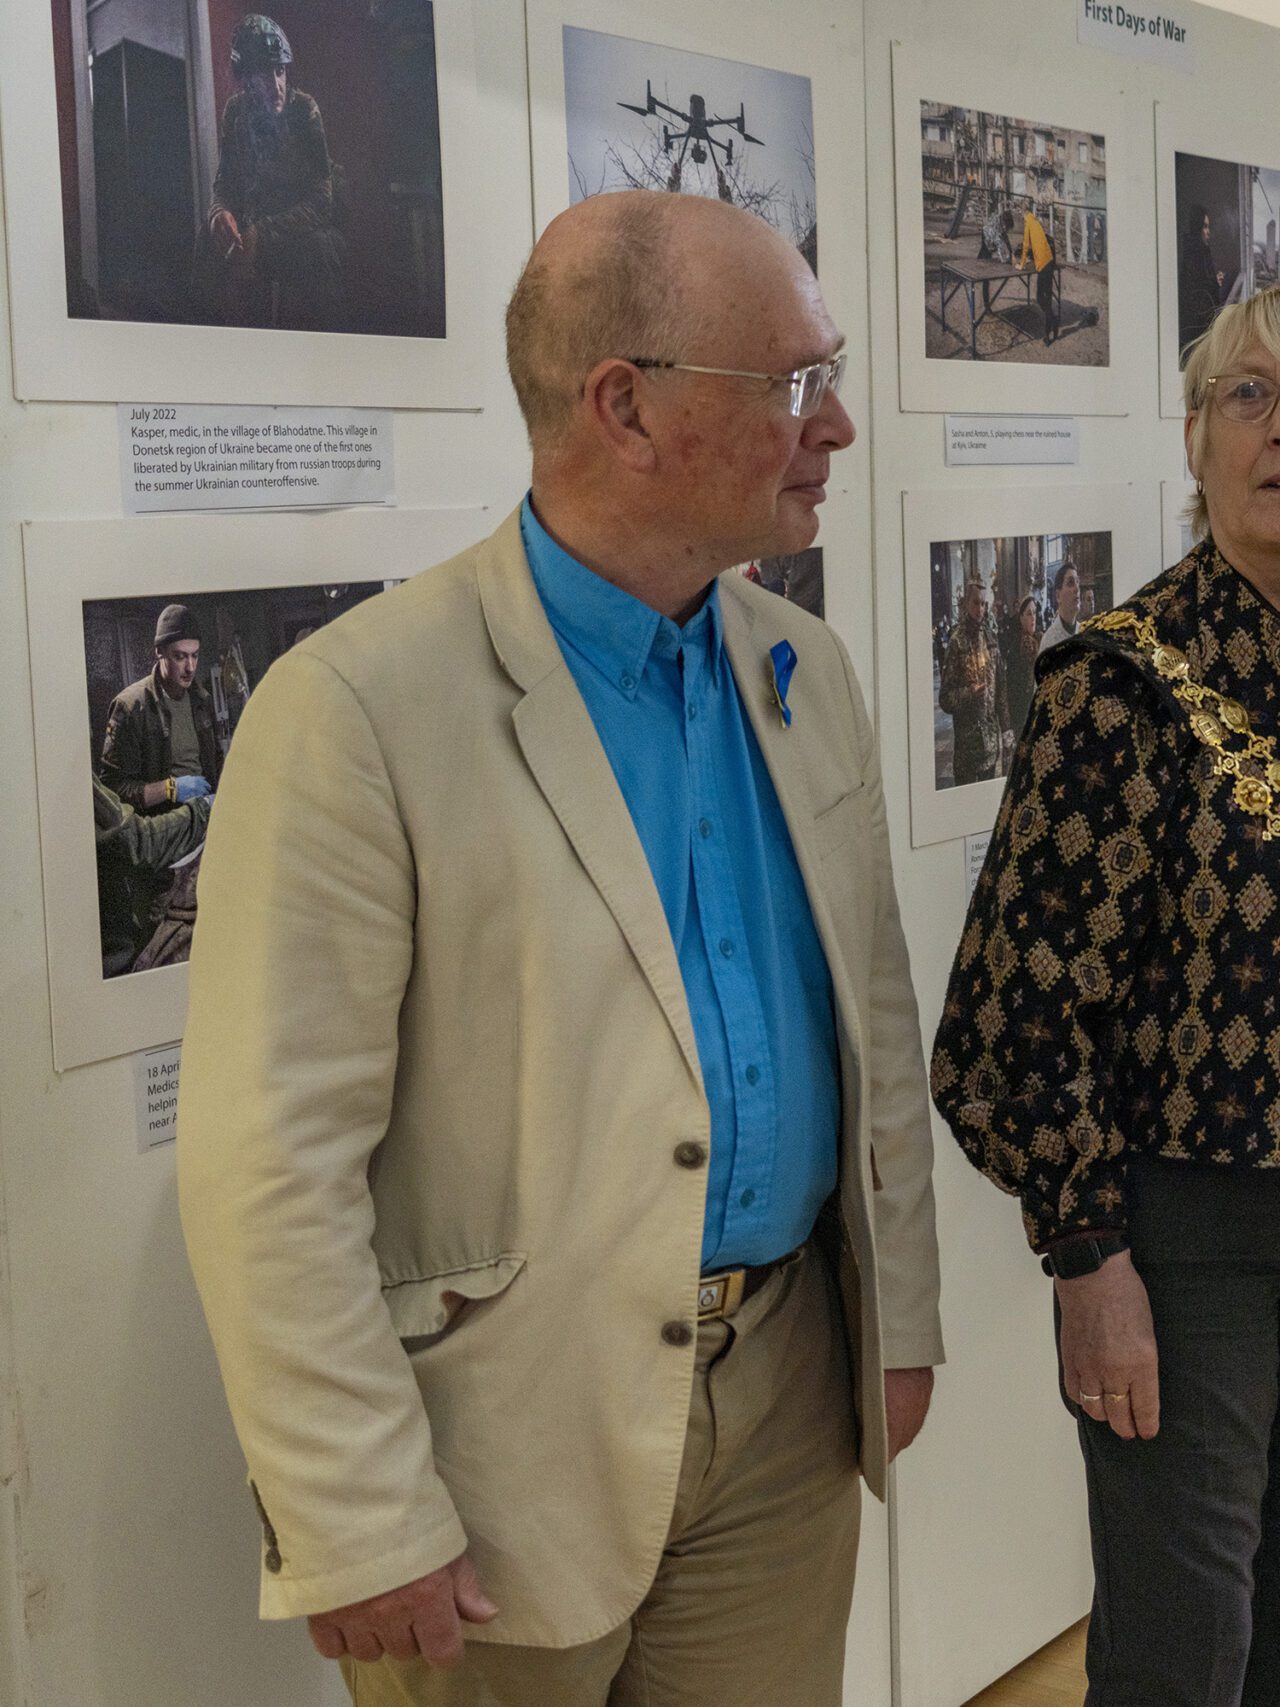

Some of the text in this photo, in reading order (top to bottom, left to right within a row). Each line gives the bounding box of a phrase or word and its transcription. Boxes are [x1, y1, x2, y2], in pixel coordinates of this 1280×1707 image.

[1085, 0, 1186, 42] First Days of War
[131, 408, 176, 422] July 2022
[131, 425, 378, 440] Kasper, medic, in the village of Blahodatne. This village in
[132, 441, 372, 458] Donetsk region of Ukraine became one of the first ones
[134, 458, 381, 475] liberated by Ukrainian military from russian troops during
[135, 476, 320, 492] the summer Ukrainian counteroffensive.
[148, 1060, 180, 1078] 18 Apri
[148, 1080, 180, 1096] Medics
[148, 1096, 178, 1113] helpin
[149, 1116, 170, 1131] near
